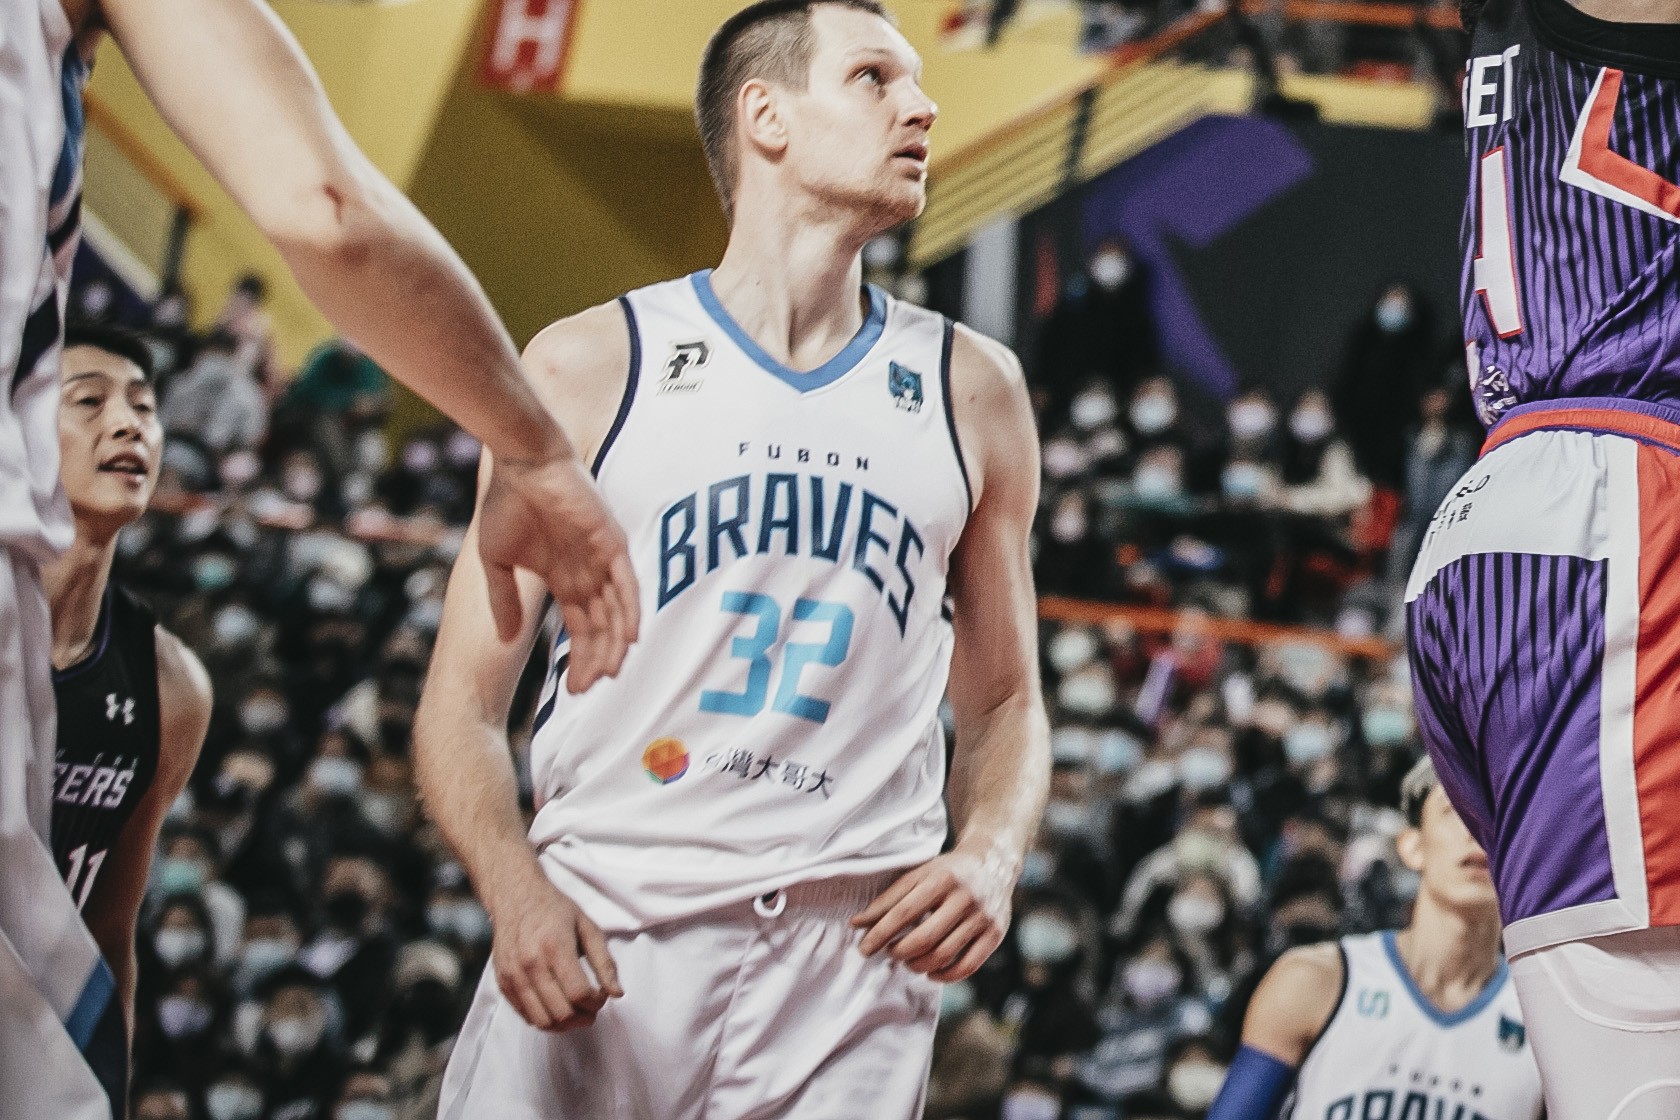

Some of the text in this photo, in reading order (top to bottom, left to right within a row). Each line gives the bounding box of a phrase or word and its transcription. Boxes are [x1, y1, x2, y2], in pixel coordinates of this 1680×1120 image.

[1462, 44, 1521, 129] ET
[738, 441, 869, 471] FUBON
[656, 472, 924, 640] BRAVES
[698, 591, 855, 724] 32
